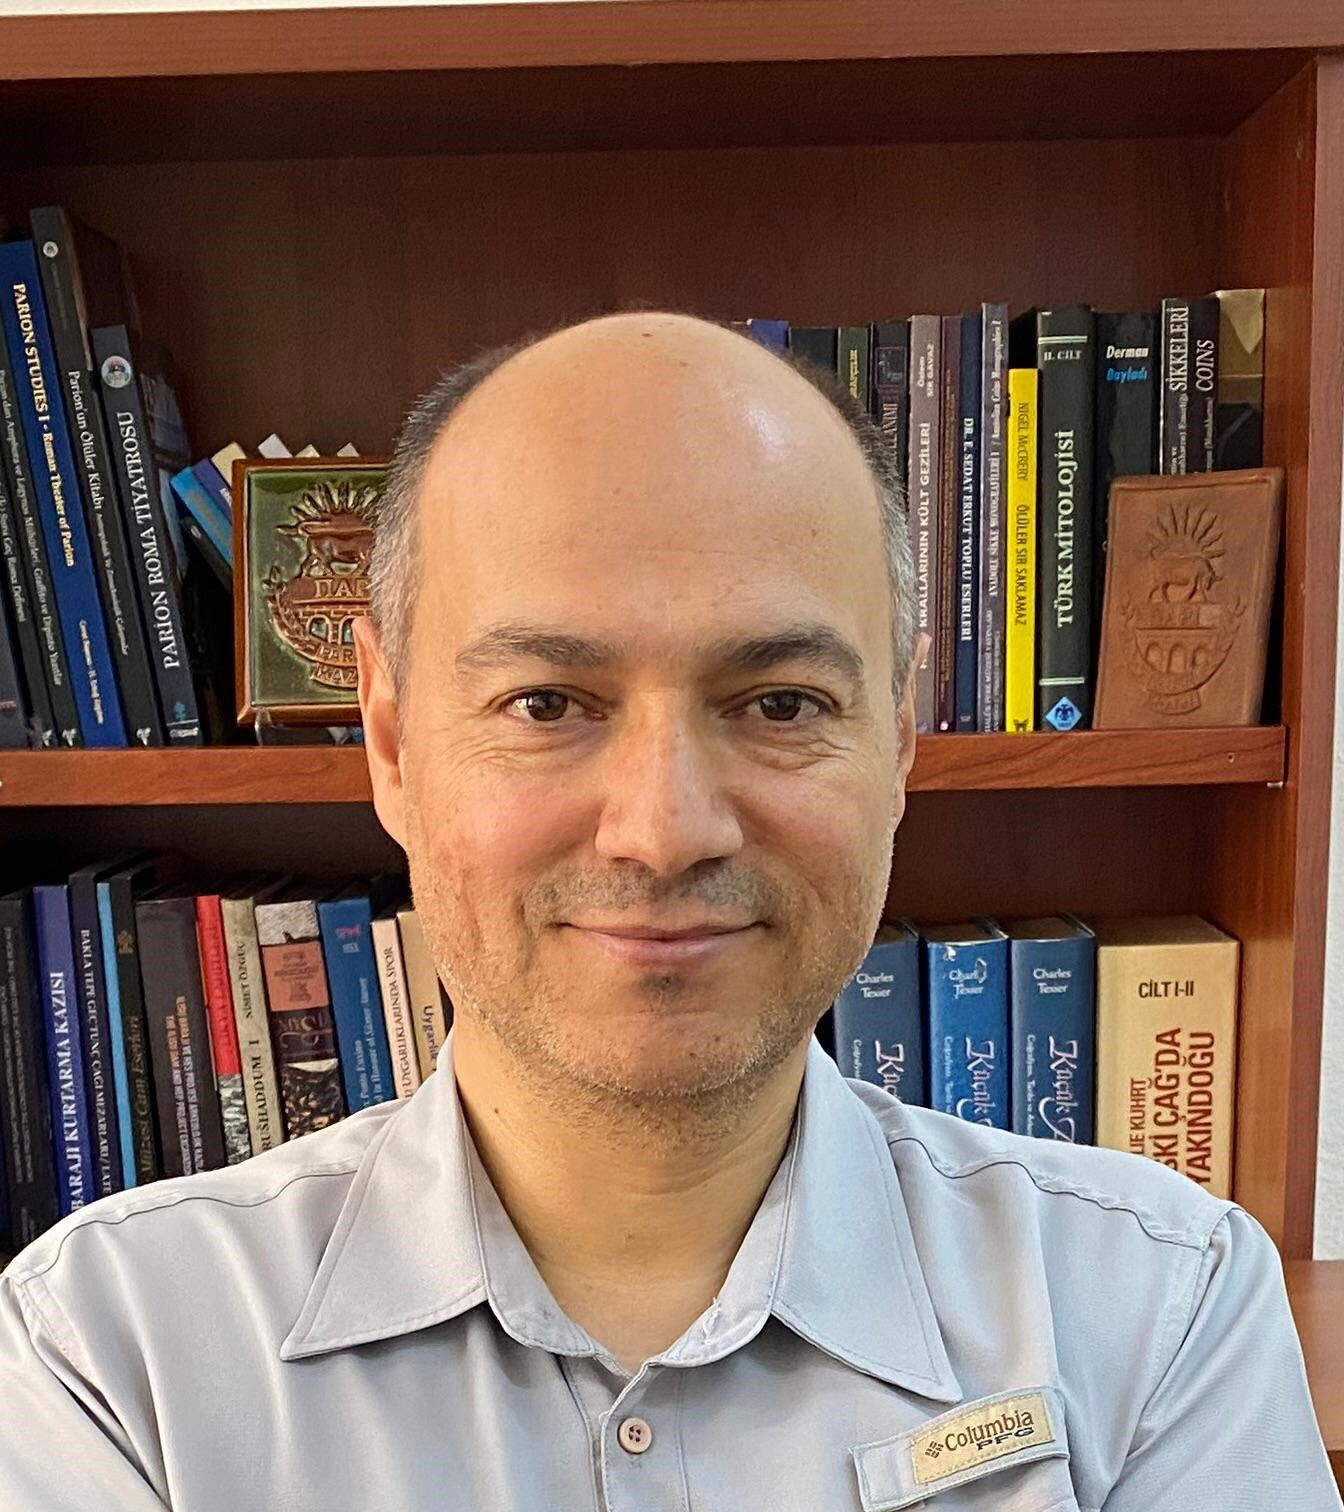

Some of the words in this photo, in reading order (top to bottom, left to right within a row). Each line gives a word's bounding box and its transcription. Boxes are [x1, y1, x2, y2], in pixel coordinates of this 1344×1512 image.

[13, 283, 36, 344] PARION
[1106, 345, 1148, 358] Derman
[1166, 306, 1188, 390] SİKKELERİ
[1195, 339, 1214, 391] COINS
[24, 346, 48, 413] STUDIES
[68, 370, 87, 429] Parion'un
[80, 430, 97, 470] Ölüler
[919, 422, 930, 486] GEZİLERİ
[963, 418, 972, 438] DR.
[88, 472, 104, 509] Kitabı
[116, 412, 152, 524] TİYATROSU
[962, 454, 972, 492] SEDAT
[50, 473, 65, 516] Theater
[917, 490, 929, 525] KÜLT
[962, 495, 972, 532] ERKUT
[1054, 430, 1078, 559] MİTOLOJİSİ
[58, 517, 69, 528] of
[61, 531, 74, 566] Parion
[1015, 504, 1029, 544] ÖLÜLER
[140, 526, 164, 585] ROMA
[918, 530, 929, 627] KRALLARININ
[961, 537, 972, 579] TOPLU
[1015, 548, 1027, 564] SIR
[961, 583, 972, 640] ESERLERİ
[1015, 567, 1027, 625] SAKLAMAZ
[1053, 563, 1073, 628] TÜRK
[150, 590, 179, 669] PARİON
[80, 929, 92, 968] BAKLA
[383, 946, 396, 978] SPOR
[1033, 968, 1072, 980] Charles
[50, 972, 69, 1034] KAZISI
[84, 971, 96, 996] TEPE
[856, 972, 894, 985] Charles
[1139, 979, 1171, 998] CİLT
[1174, 980, 1194, 997] I-II
[90, 1026, 100, 1056] TUNÇ
[389, 980, 412, 1087] UYGARLIKLARINDA
[57, 1038, 79, 1142] KURTARMA
[966, 1036, 996, 1114] Küçük
[1048, 1035, 1078, 1113] Küçük
[1147, 1028, 1187, 1127] ÇAĞ'DA
[1130, 1078, 1146, 1131] KUHRT
[1181, 1032, 1215, 1183] YAKINDOĞU
[66, 1146, 86, 1210] BARAJI
[945, 1410, 1034, 1451] Columbia
[976, 1426, 1035, 1451] PFG
